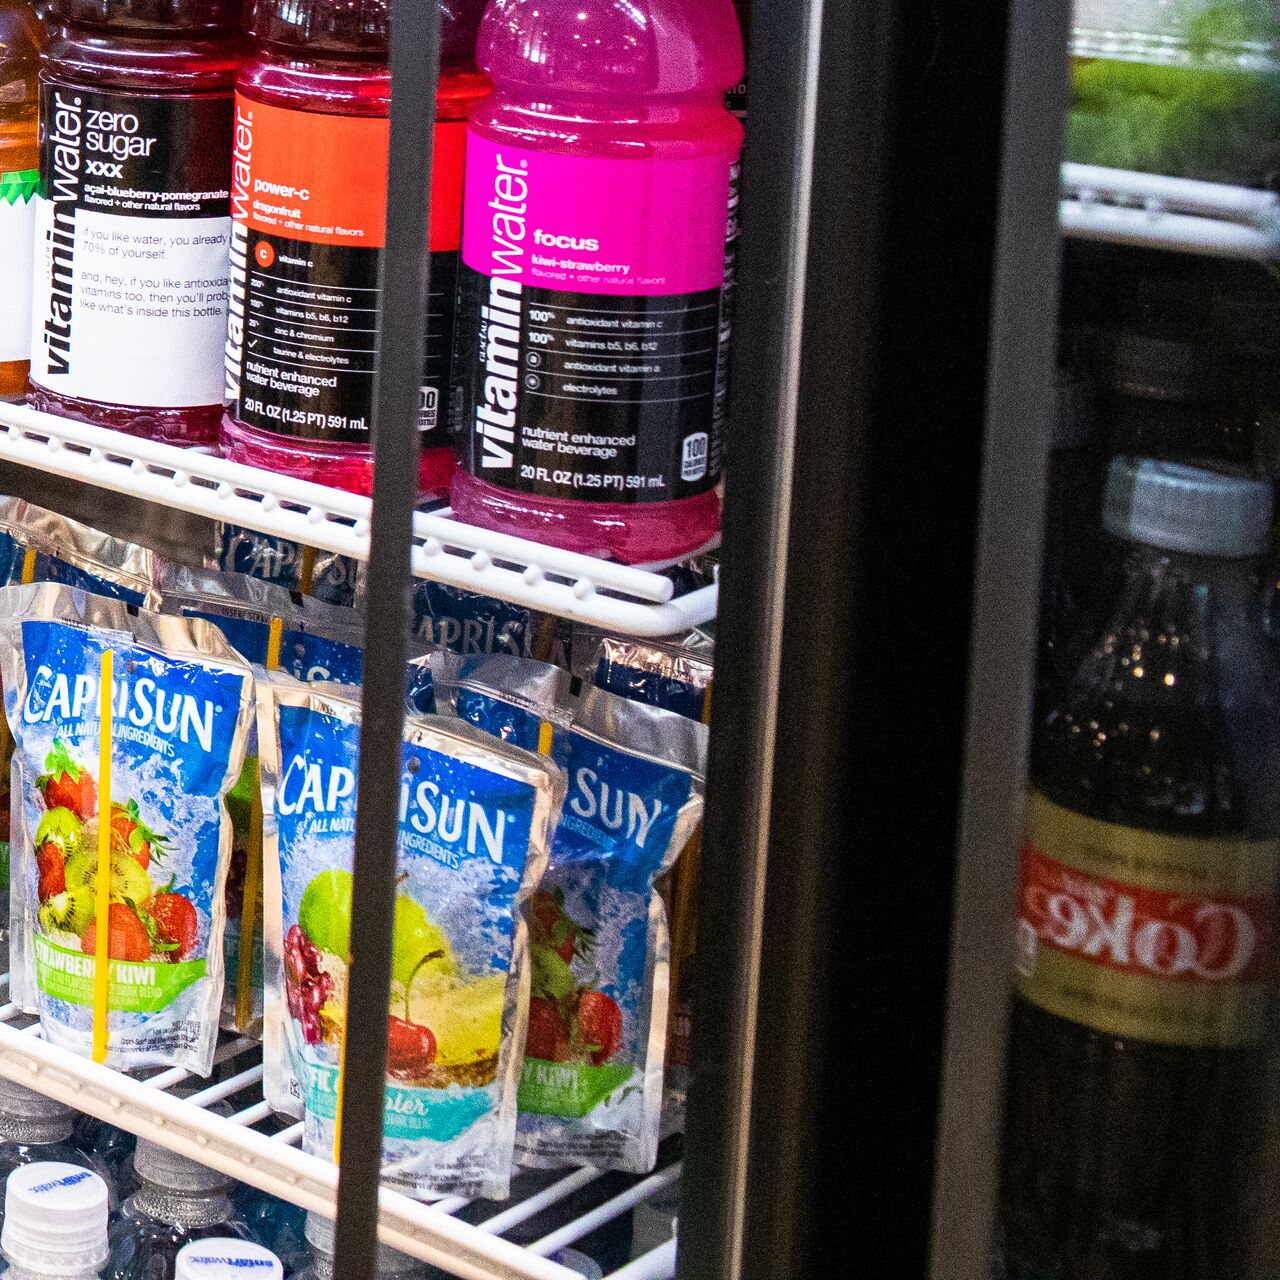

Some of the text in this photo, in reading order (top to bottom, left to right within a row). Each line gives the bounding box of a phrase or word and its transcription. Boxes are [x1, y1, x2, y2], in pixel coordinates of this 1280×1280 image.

[85, 109, 139, 134] zero
[85, 131, 156, 160] sugar
[85, 159, 123, 179] xxx
[254, 179, 310, 201] power-c
[144, 202, 200, 211] natural flavors
[252, 199, 301, 219] dragonfruit
[45, 93, 82, 375] vitaminwater
[169, 234, 228, 247] you already
[335, 226, 364, 237] flavors
[533, 229, 600, 251] focus
[122, 247, 166, 260] yourself.
[531, 253, 630, 276] kiwi-strawberry
[139, 278, 181, 290] you like
[81, 286, 173, 303] vitamins then
[315, 293, 345, 303] vitamin
[136, 304, 223, 317] inside this bottle.
[275, 306, 304, 319] vitamins
[476, 154, 528, 468] vitaminwater
[297, 331, 334, 343] chromium
[305, 351, 349, 365] electrolytes
[246, 361, 337, 388] nutrient enhanced
[270, 378, 320, 397] beverage
[562, 383, 618, 396] electrolytes
[327, 414, 369, 430] 591 mL
[522, 425, 636, 446] nutrient enhanced
[522, 437, 617, 459] water beverage
[626, 476, 645, 489] 591
[130, 678, 213, 752] SUN
[56, 723, 175, 757] ALL INGREDIENTS
[570, 766, 663, 847] SUN
[411, 781, 508, 864] SUN
[117, 964, 156, 986] KIWI
[188, 1256, 274, 1268] smartwater
